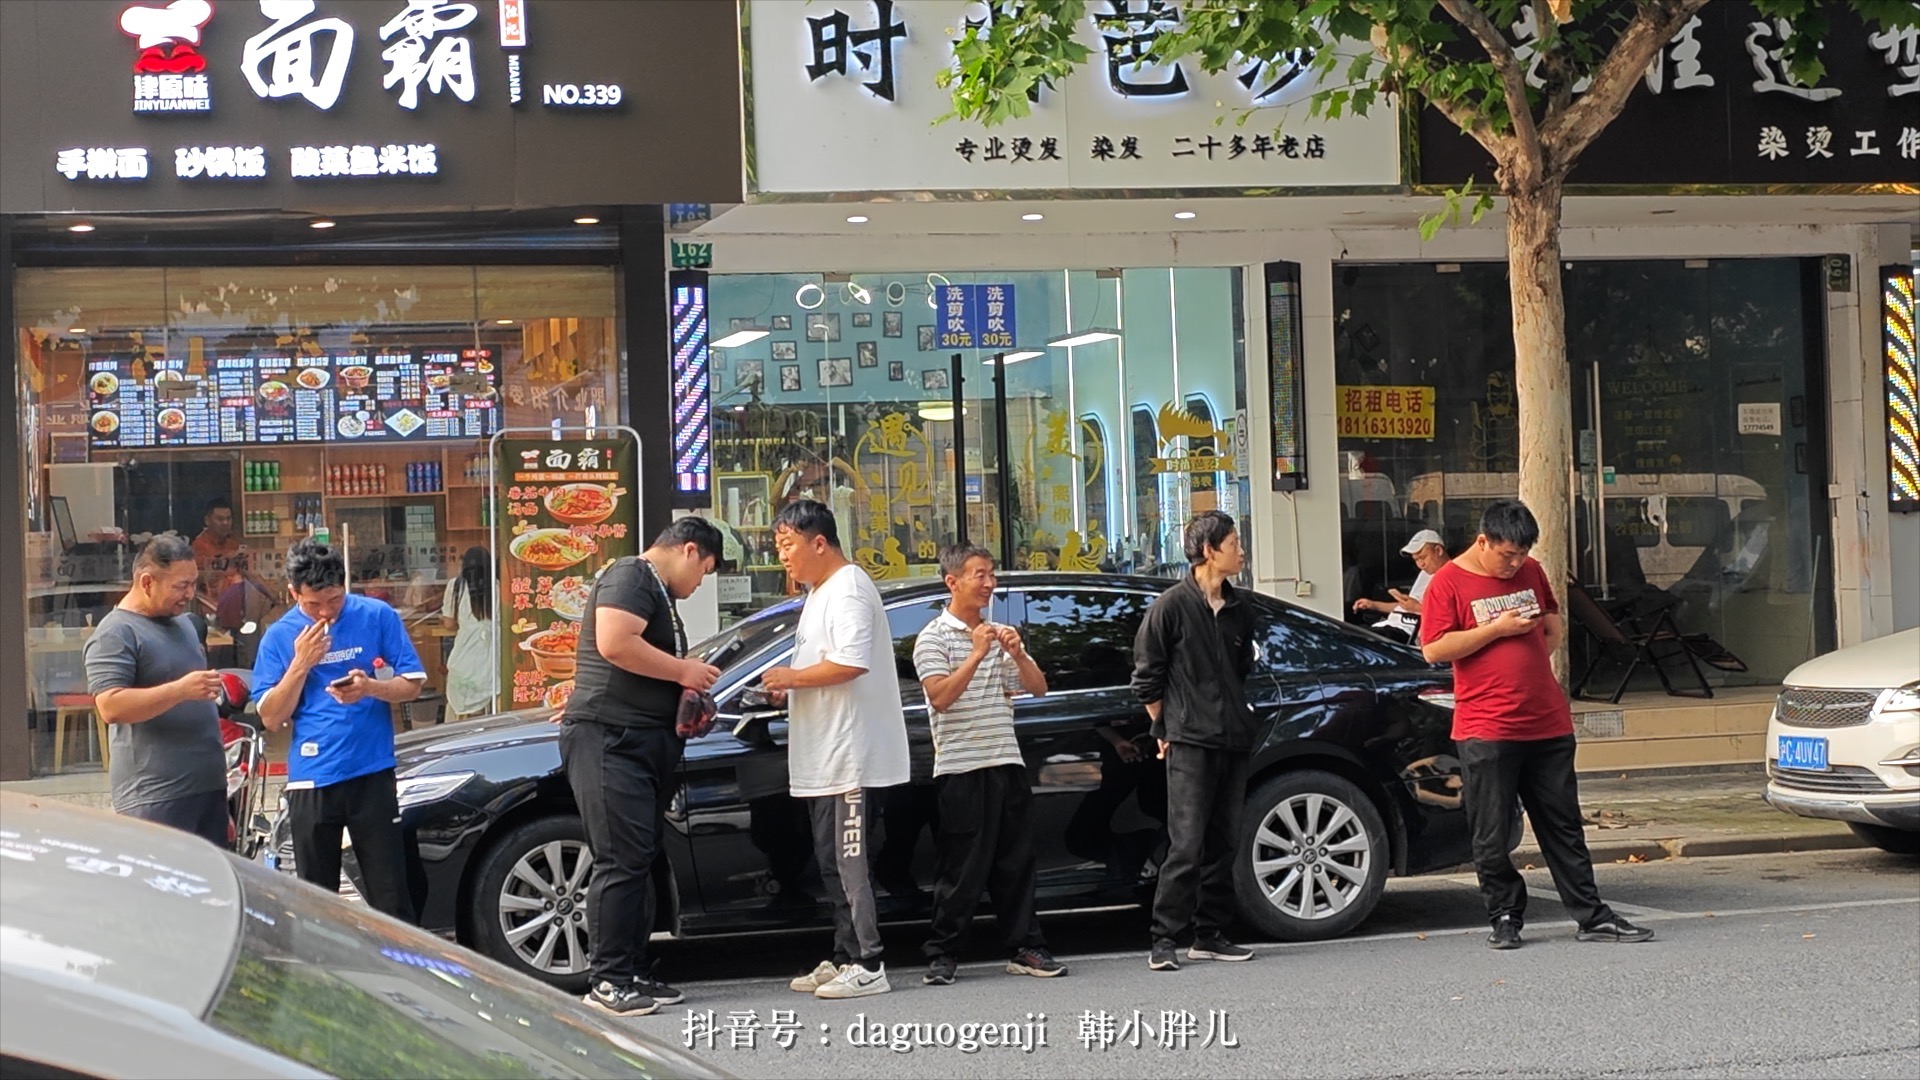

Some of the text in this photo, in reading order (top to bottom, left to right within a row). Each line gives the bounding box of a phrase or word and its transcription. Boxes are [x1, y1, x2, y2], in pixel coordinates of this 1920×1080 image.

[508, 54, 522, 104] MIANBA
[133, 98, 211, 112] JINYUANWEI
[543, 84, 622, 105] NO.339
[955, 133, 1326, 164] 专业烫发 染发 二十多年老店
[174, 146, 267, 178] 砂锅饭
[290, 143, 438, 178] 酸菜鱼米饭
[677, 243, 708, 258] 162
[946, 286, 965, 332] 洗剪吹
[986, 286, 1005, 332] 洗剪吹
[941, 332, 972, 347] 30元
[982, 332, 1012, 347] 30元
[1345, 388, 1423, 414] 招租电话
[1338, 416, 1431, 435] 18116313920
